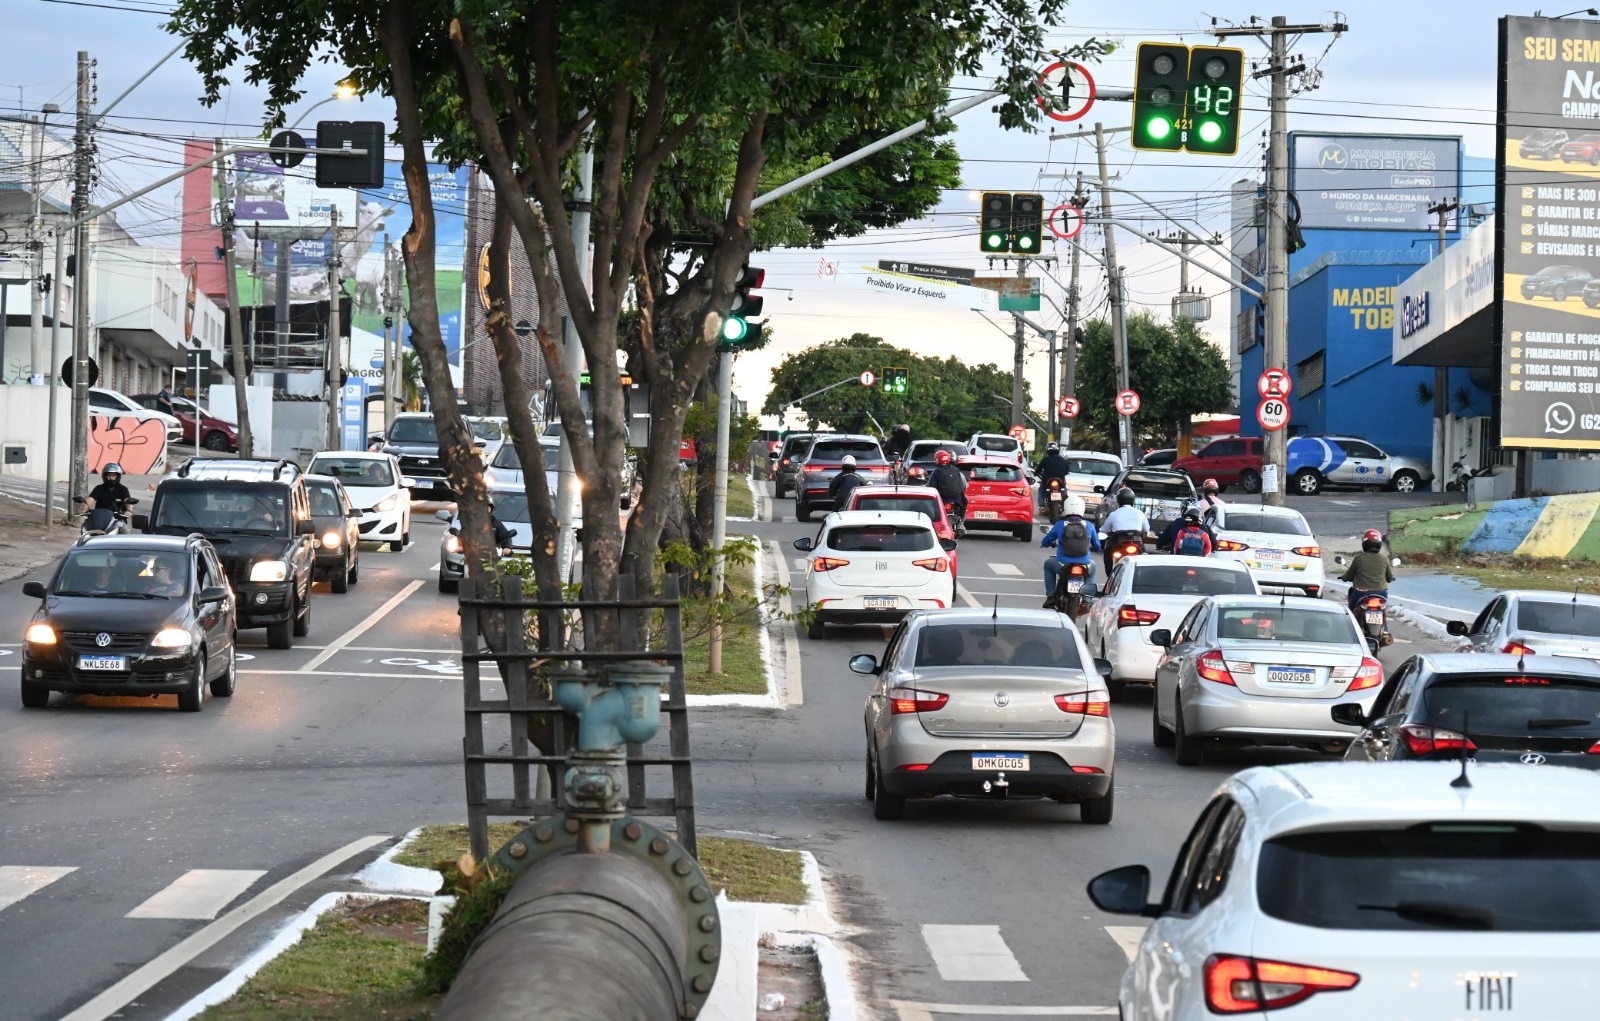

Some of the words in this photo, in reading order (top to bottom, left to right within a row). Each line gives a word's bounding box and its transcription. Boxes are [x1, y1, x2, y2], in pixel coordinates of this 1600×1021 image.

[1524, 36, 1557, 61] SEU
[1561, 38, 1600, 64] SEM
[1194, 85, 1233, 115] 42
[1174, 119, 1193, 130] 421
[1180, 131, 1188, 143] B
[1350, 148, 1436, 161] MADEIREIRA
[1350, 159, 1436, 173] TOBIAS
[1394, 177, 1432, 187] RedePRO
[1320, 192, 1328, 200] O
[1329, 192, 1361, 201] MUNDO
[1362, 193, 1375, 202] DA
[1376, 194, 1431, 203] MARCENARIA
[1537, 186, 1562, 200] MAIS
[1563, 187, 1576, 201] DE
[1577, 188, 1597, 202] 300
[1537, 204, 1581, 219] GARANTIA
[1582, 207, 1595, 220] DE
[1536, 221, 1570, 238] VÁRIAS
[1536, 241, 1586, 257] REVISADOS
[1587, 244, 1594, 257] E
[866, 276, 895, 291] Proibido
[895, 281, 911, 294] Virar
[917, 286, 947, 300] Esquerda
[1350, 307, 1395, 330] TOB
[1525, 331, 1564, 344] GARANTIA
[1565, 333, 1576, 345] DE
[1525, 347, 1588, 361] FINANCIAMENTO
[1525, 363, 1550, 376] TROCA
[1552, 364, 1571, 377] COM
[1573, 365, 1599, 378] TROCO
[895, 376, 907, 385] 64
[1525, 380, 1577, 393] COMPRAMOS
[1578, 382, 1594, 394] SEU
[1265, 402, 1283, 416] 60
[84, 660, 120, 669] NKL5E68
[1464, 972, 1517, 1011] FIAT
